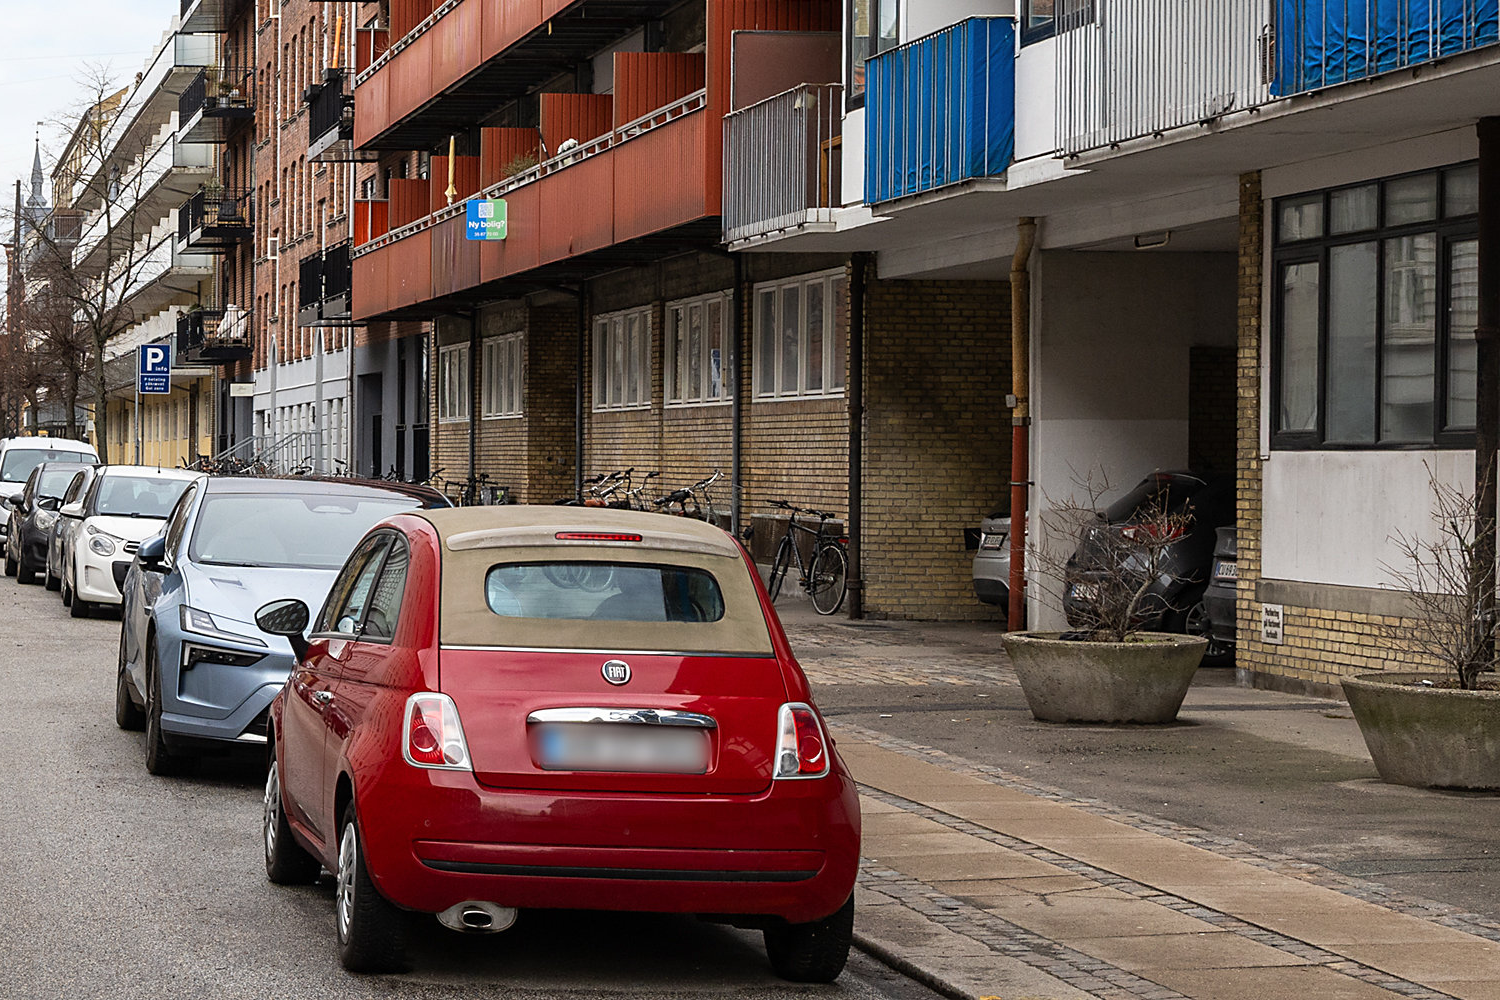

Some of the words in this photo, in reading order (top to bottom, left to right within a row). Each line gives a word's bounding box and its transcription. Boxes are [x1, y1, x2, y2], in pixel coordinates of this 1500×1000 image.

[468, 221, 479, 230] Ny
[480, 220, 505, 229] bolig?
[147, 348, 164, 371] P
[608, 666, 625, 678] FIAT
